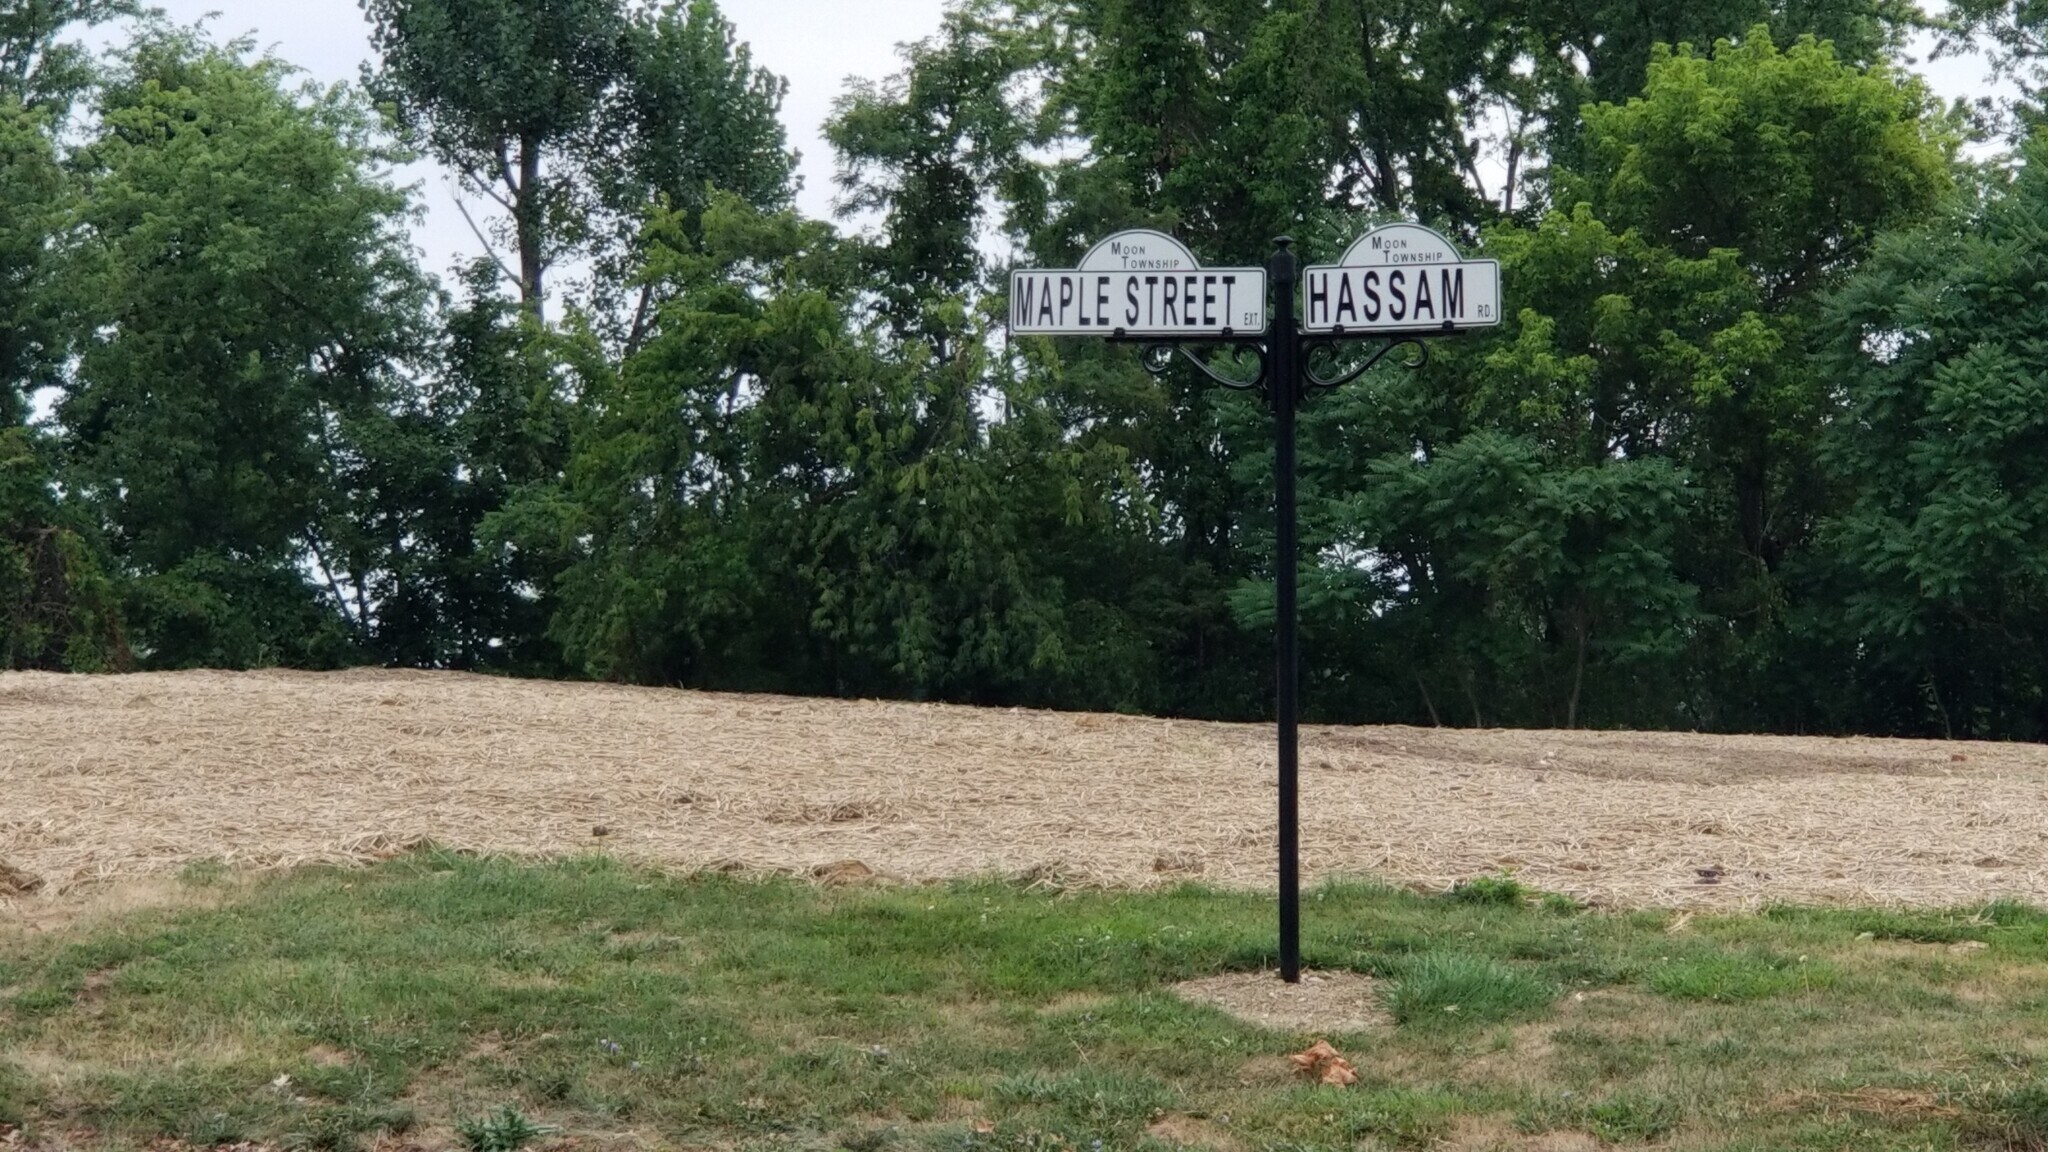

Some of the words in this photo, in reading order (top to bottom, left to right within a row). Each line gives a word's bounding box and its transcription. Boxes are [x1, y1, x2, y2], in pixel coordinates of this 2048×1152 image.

[1016, 276, 1110, 326] MAPLE
[1125, 275, 1236, 326] STREET
[1310, 268, 1464, 323] HASSAM
